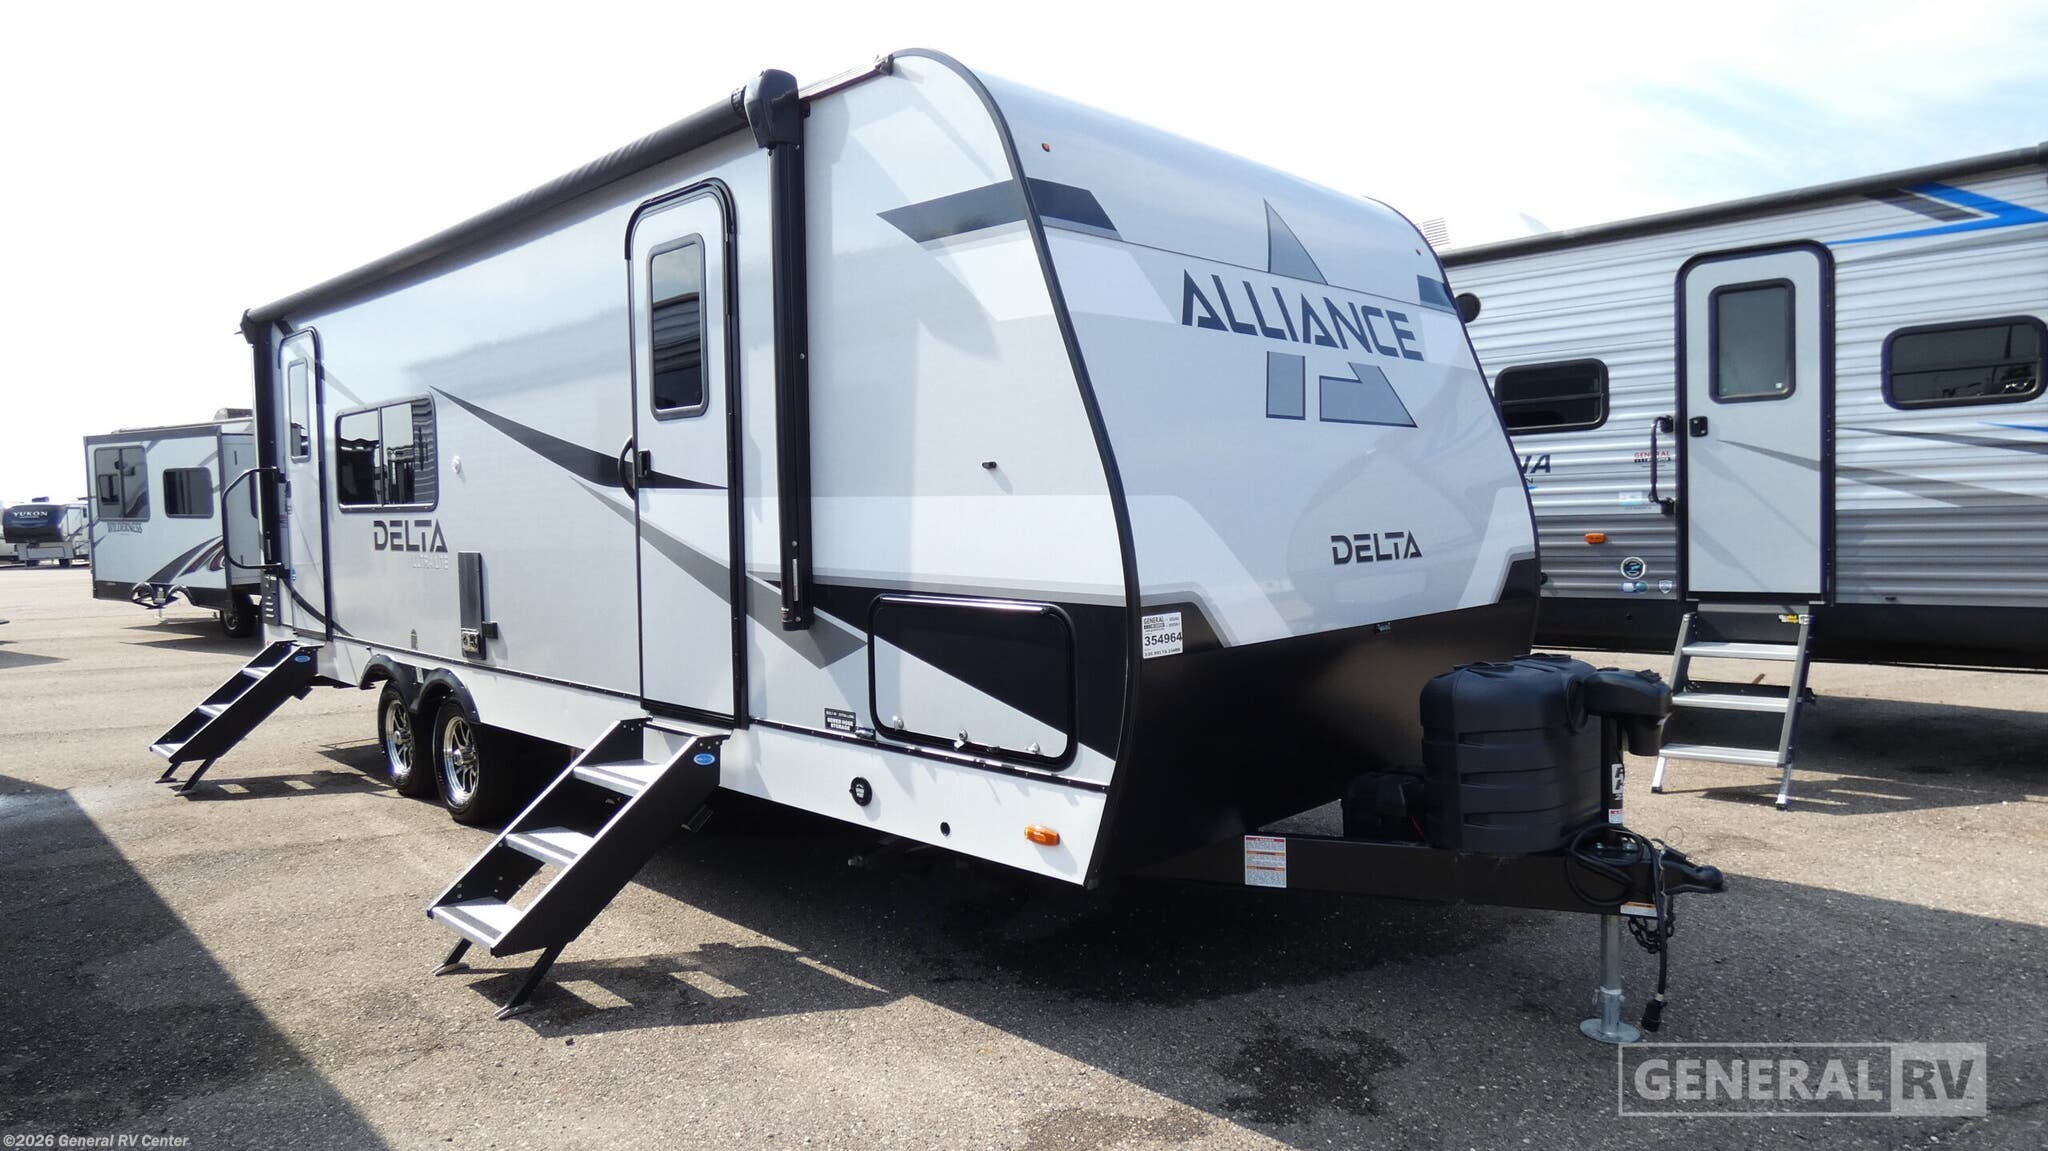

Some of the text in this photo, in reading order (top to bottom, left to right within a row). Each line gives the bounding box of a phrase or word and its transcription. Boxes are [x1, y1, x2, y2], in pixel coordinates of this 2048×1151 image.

[1182, 268, 1424, 362] ALLIANCE
[373, 518, 448, 553] DELTA
[1330, 530, 1422, 565] DELTA
[1144, 632, 1183, 646] 354964
